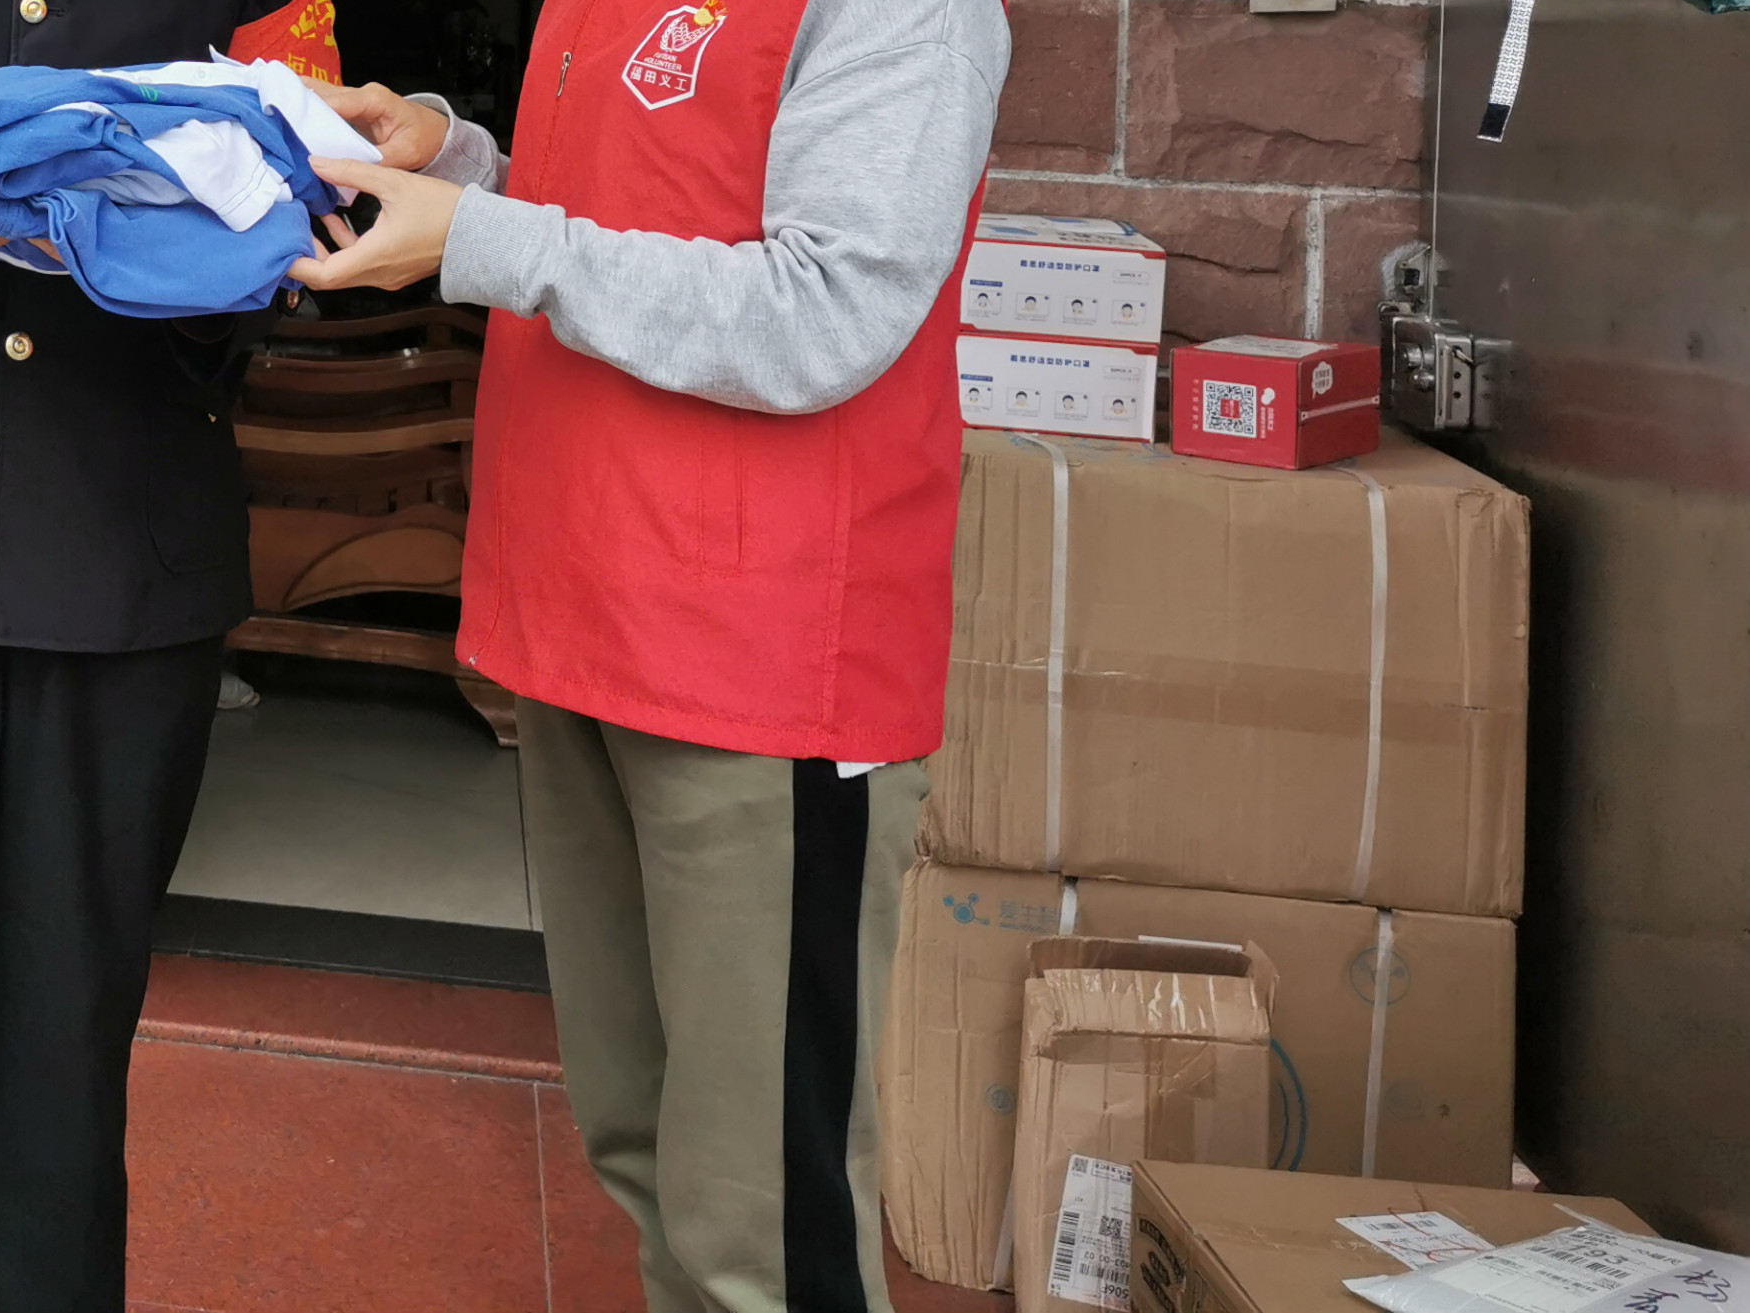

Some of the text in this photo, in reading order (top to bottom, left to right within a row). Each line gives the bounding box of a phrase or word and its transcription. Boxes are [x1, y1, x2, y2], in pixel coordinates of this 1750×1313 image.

[644, 56, 682, 71] VOLUNTEER
[630, 66, 687, 91] 福田义工
